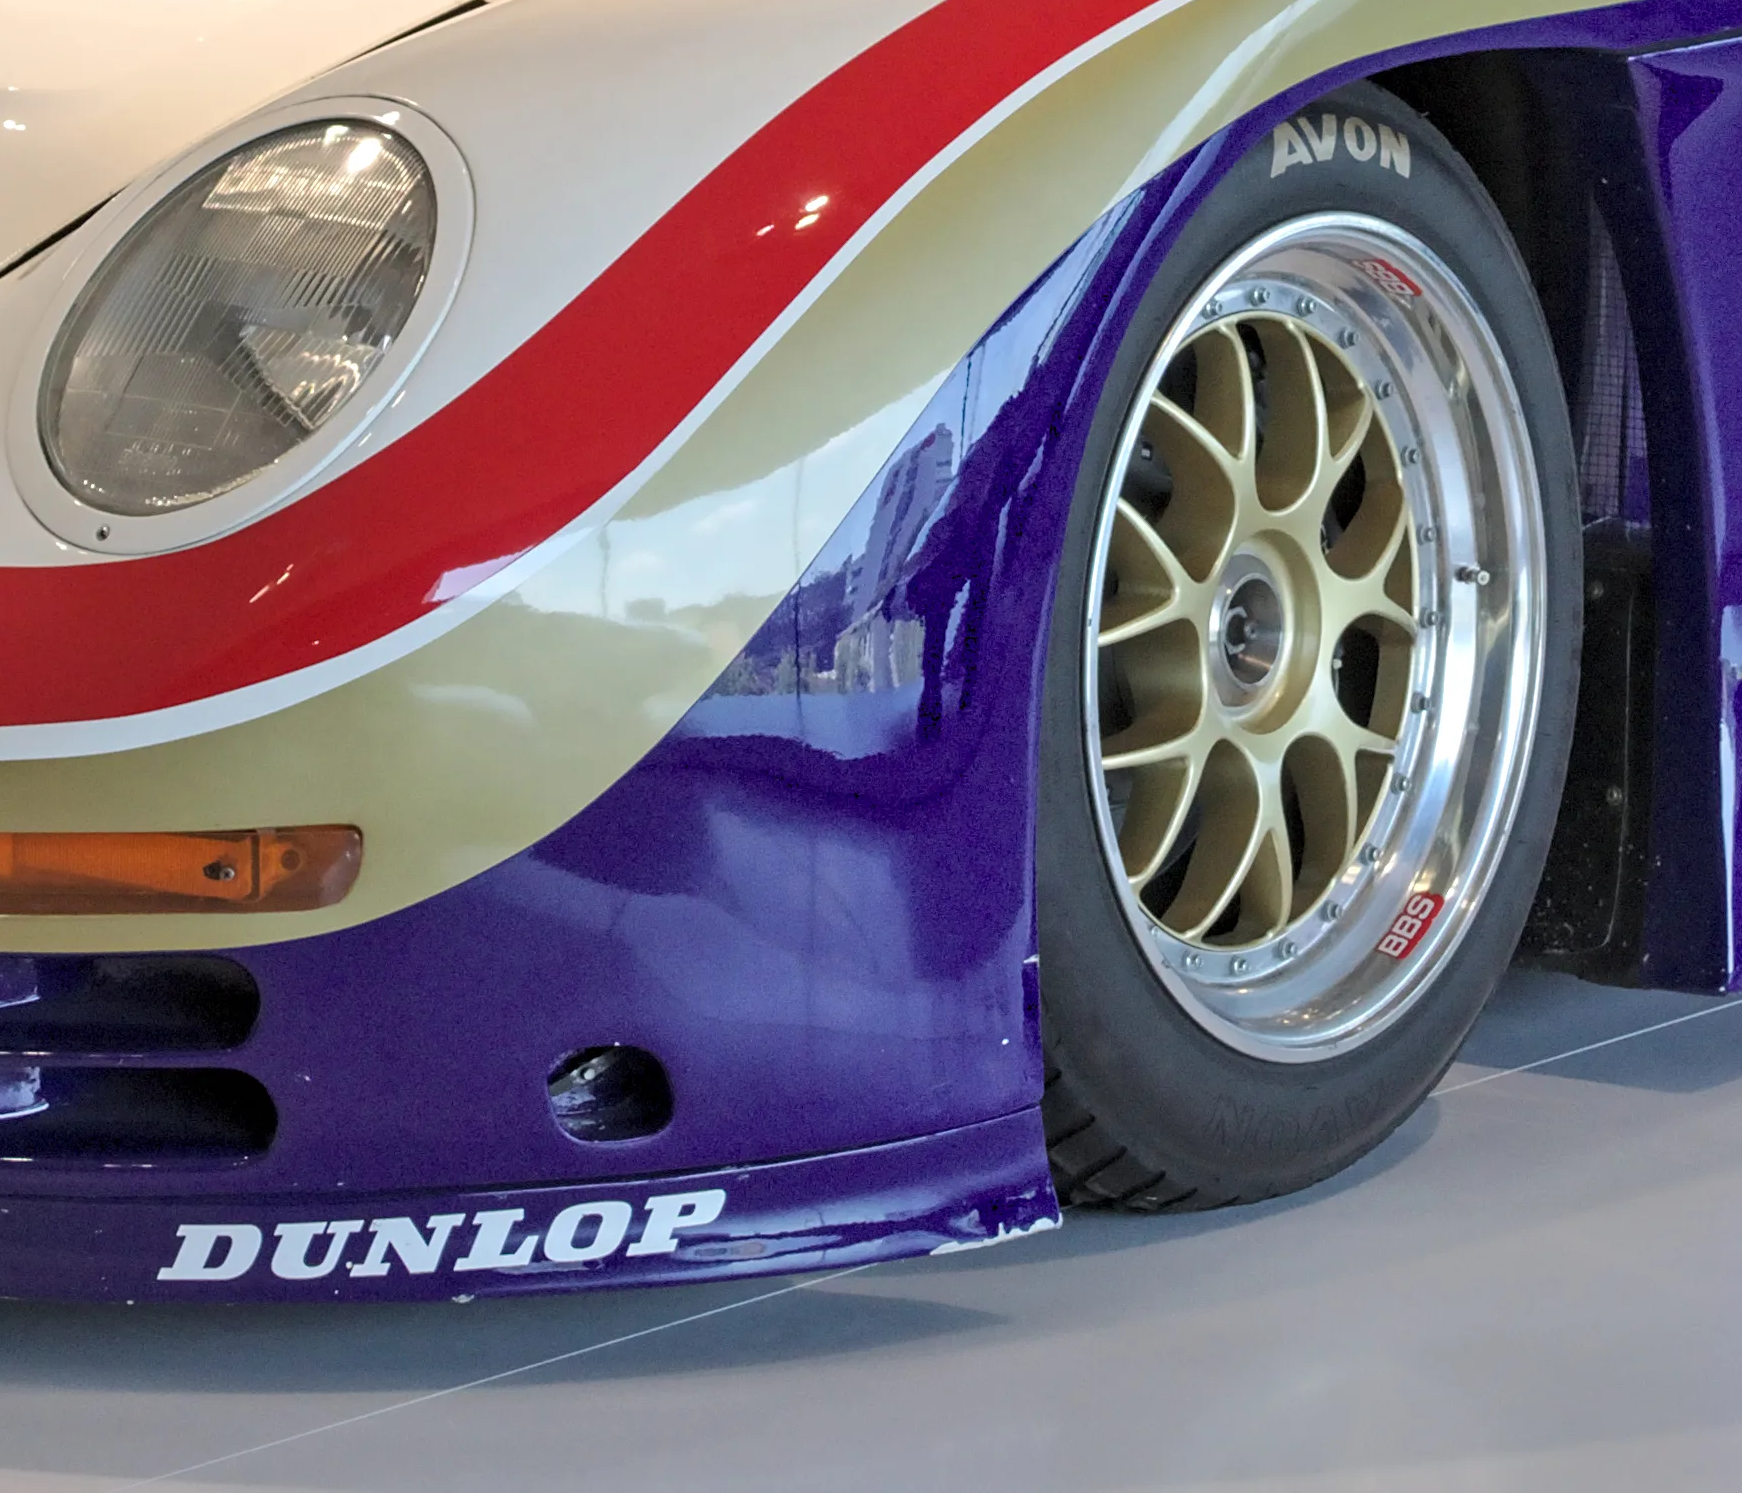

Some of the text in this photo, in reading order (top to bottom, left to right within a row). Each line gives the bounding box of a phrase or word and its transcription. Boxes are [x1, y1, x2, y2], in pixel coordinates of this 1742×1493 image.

[1270, 113, 1412, 179] AVON
[1377, 894, 1436, 958] BBS
[156, 1188, 727, 1281] DUNLOP
